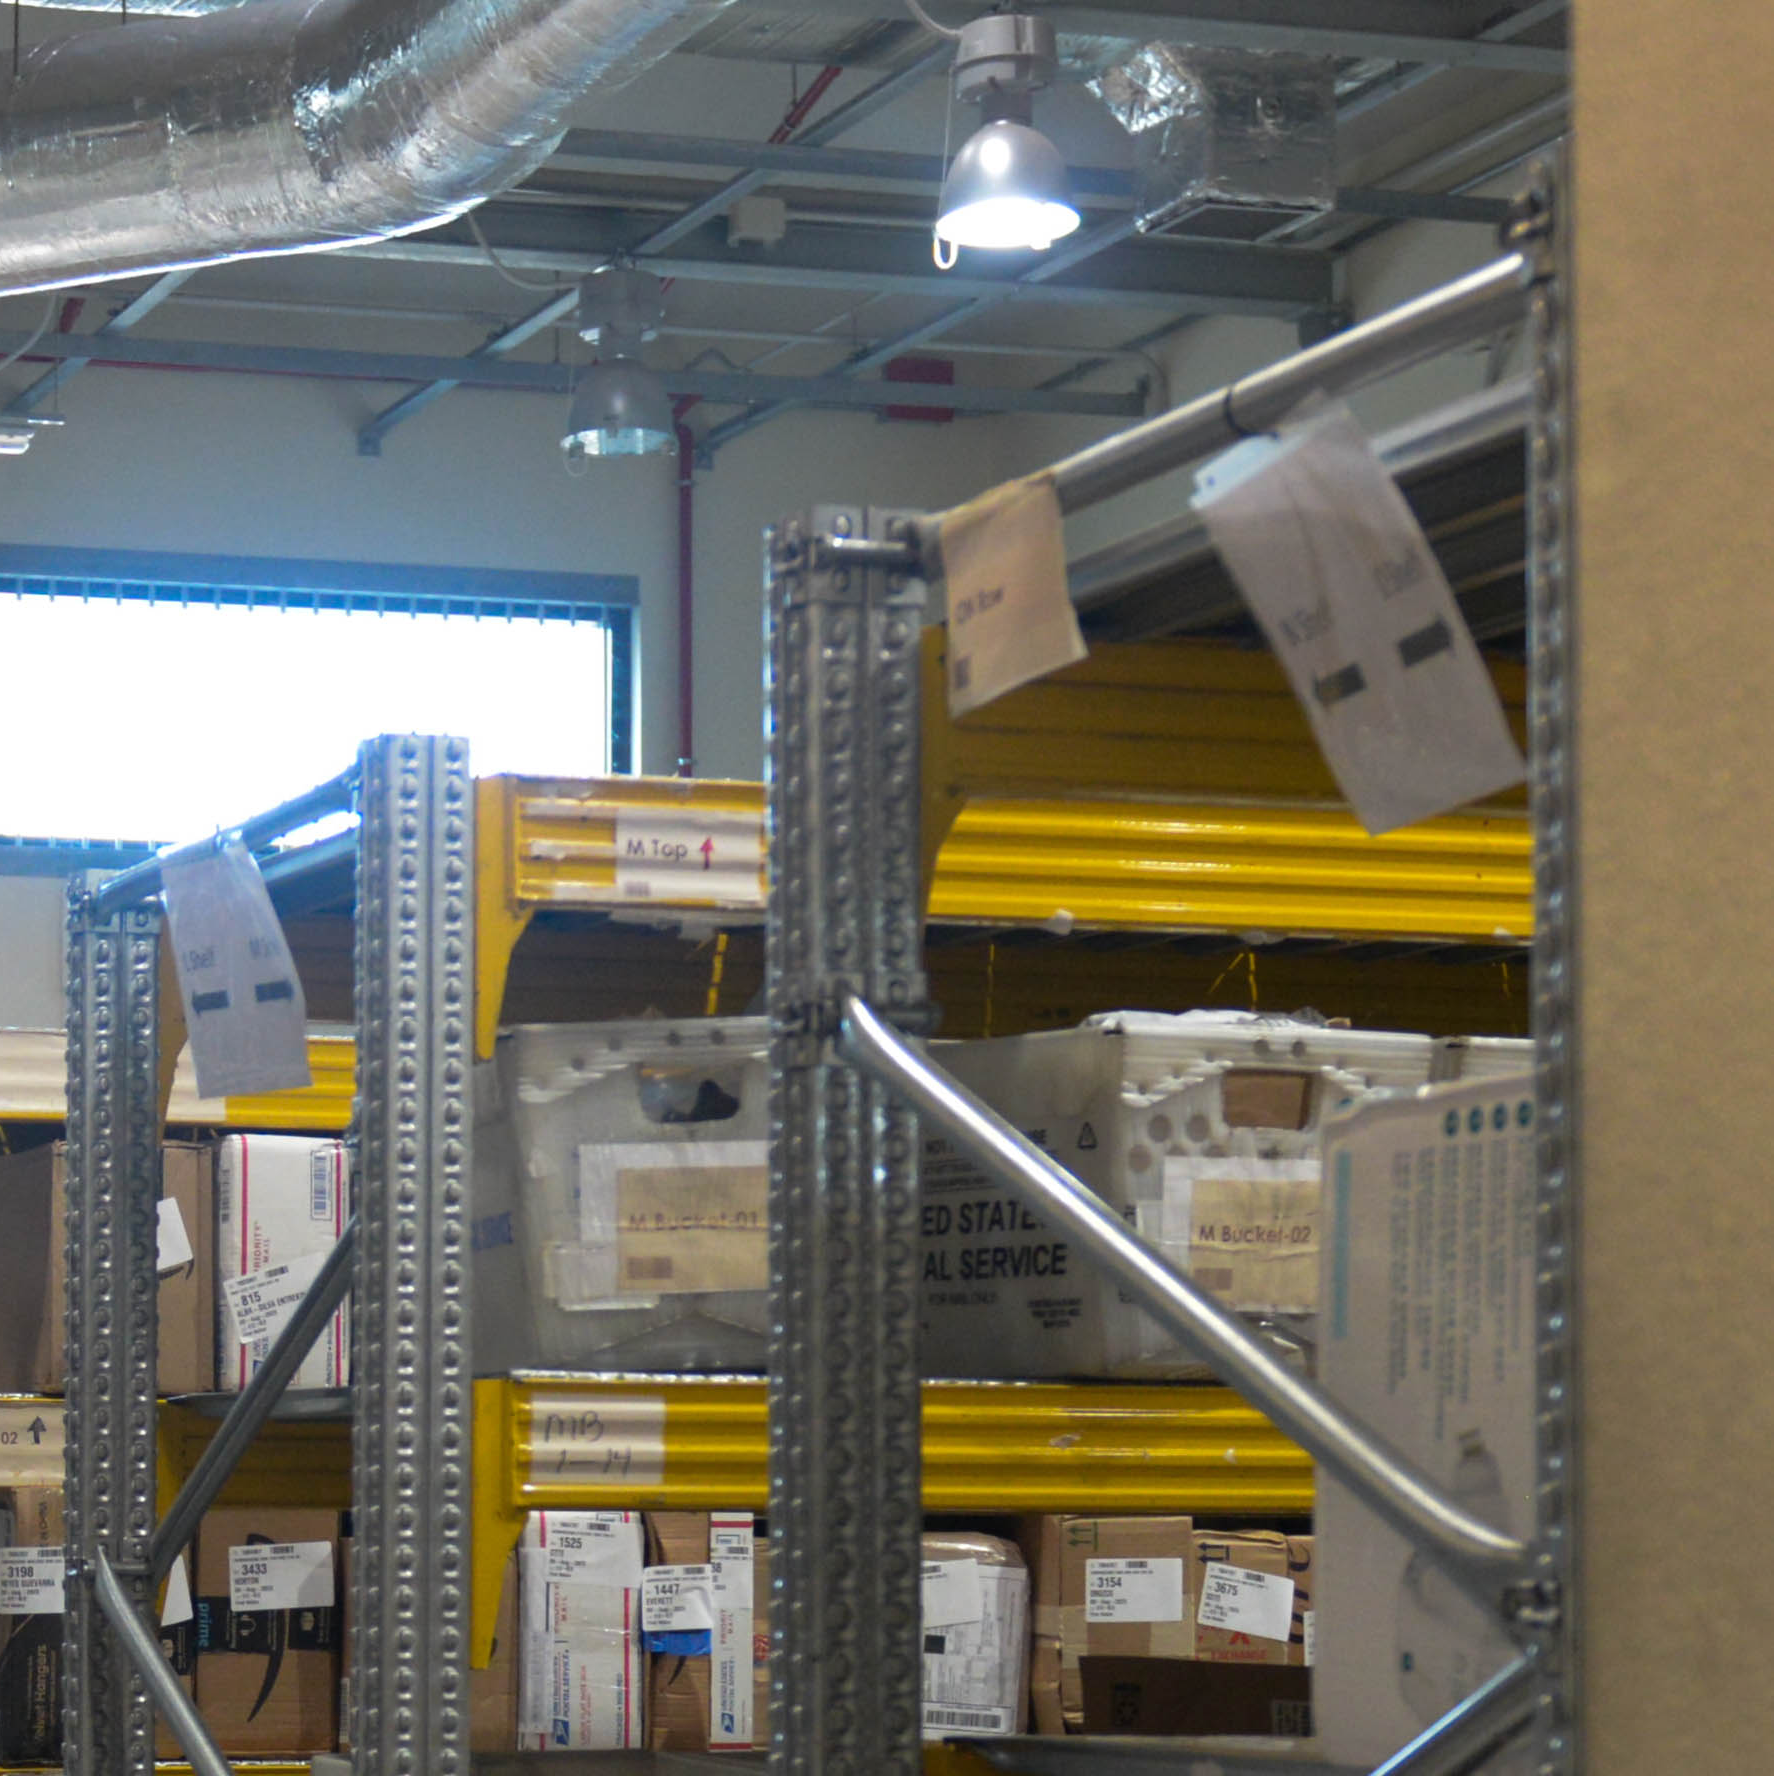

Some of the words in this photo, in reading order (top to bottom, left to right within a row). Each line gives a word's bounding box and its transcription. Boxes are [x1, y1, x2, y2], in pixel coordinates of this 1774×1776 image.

[651, 839, 688, 861] Top
[1199, 1225, 1215, 1241] M
[959, 1243, 1068, 1281] SERVICE
[241, 1291, 262, 1306] 815
[559, 1537, 582, 1549] 1525
[7, 1566, 34, 1578] 3198
[242, 1563, 267, 1576] 3433
[654, 1583, 679, 1595] 1447
[1097, 1577, 1122, 1588] 3154
[1214, 1581, 1238, 1597] 3675
[198, 1602, 212, 1647] prime
